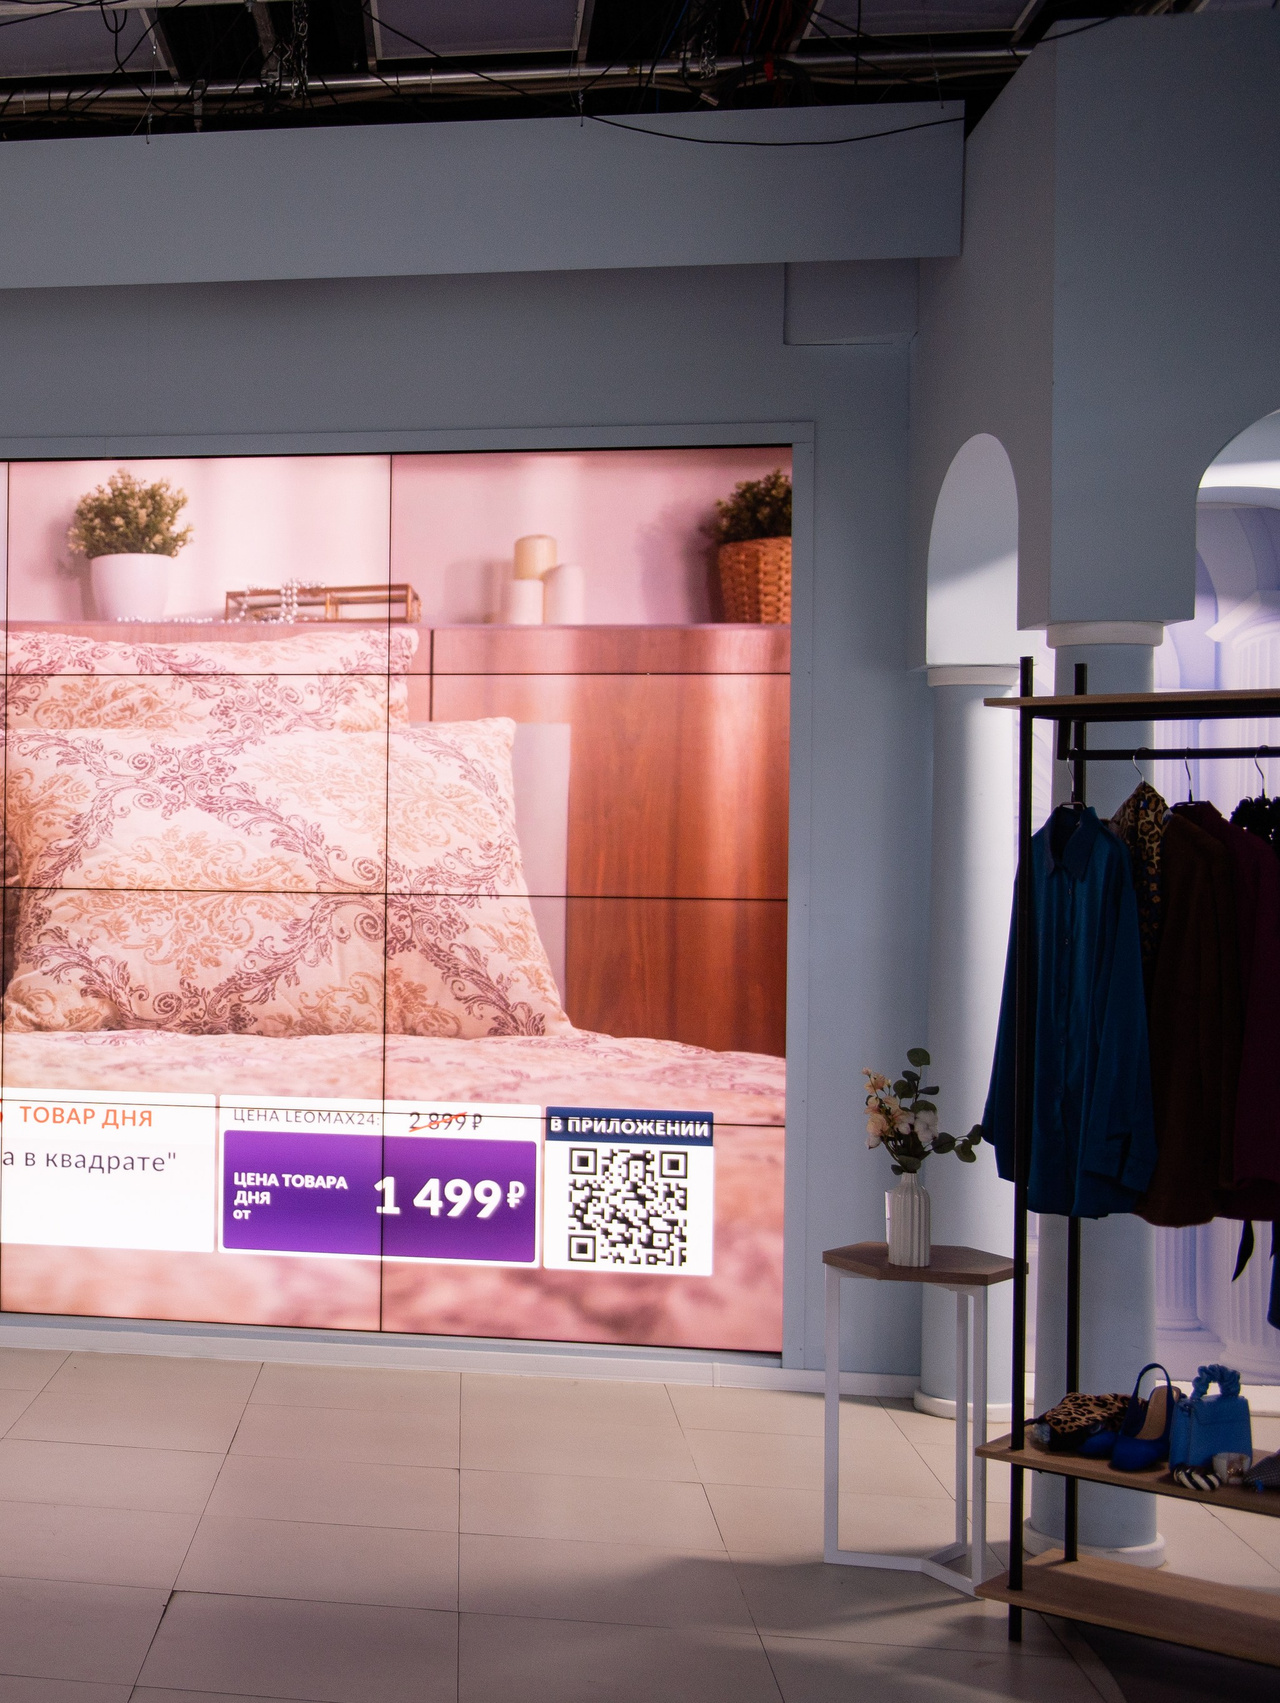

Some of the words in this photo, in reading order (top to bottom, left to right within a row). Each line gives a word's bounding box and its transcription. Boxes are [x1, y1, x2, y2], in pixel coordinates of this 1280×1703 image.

[19, 1106, 95, 1125] ТОВАР
[101, 1109, 152, 1129] ДНЯ
[233, 1108, 280, 1122] ЦЕНА
[285, 1110, 380, 1126] LEOMAX24:
[550, 1116, 562, 1132] В
[568, 1116, 709, 1137] ПРИЛОЖЕНИИ
[25, 1153, 35, 1166] в
[46, 1151, 177, 1174] квадрате"
[233, 1172, 279, 1188] ЦЕНА
[283, 1174, 348, 1190] ТОВАРА
[234, 1190, 271, 1206] ДНЯ
[374, 1177, 401, 1214] 1
[233, 1209, 251, 1219] от
